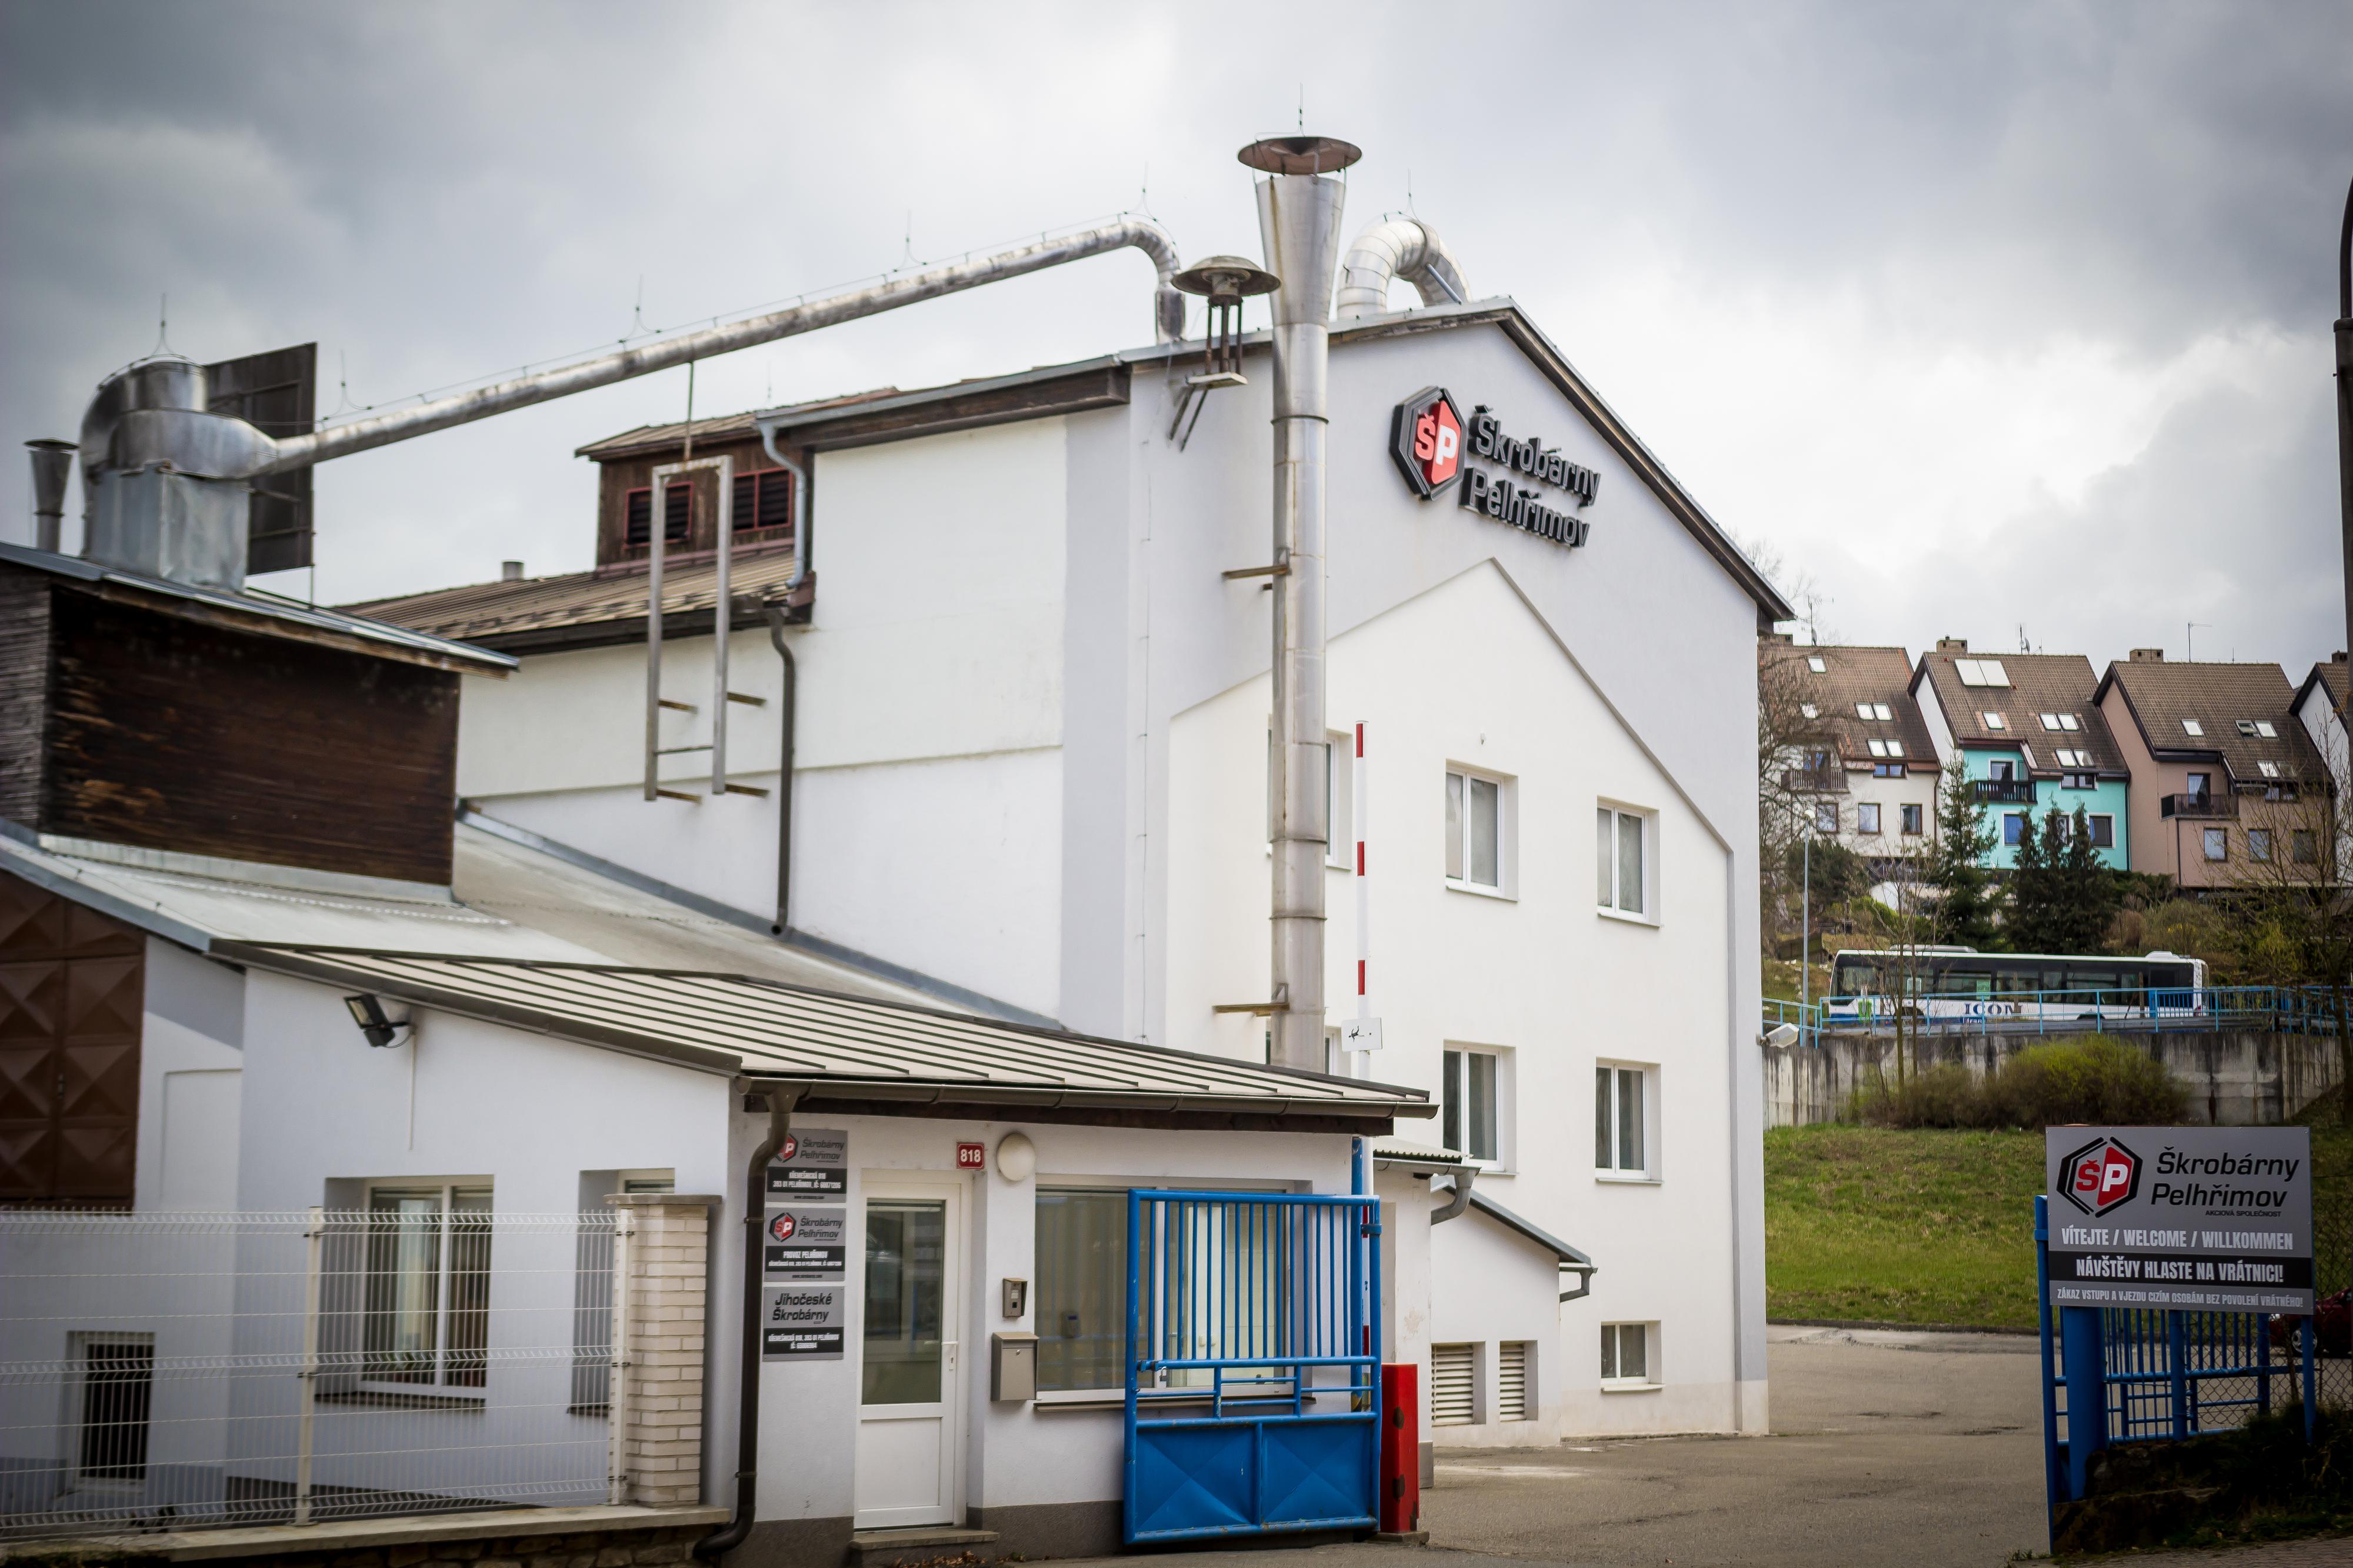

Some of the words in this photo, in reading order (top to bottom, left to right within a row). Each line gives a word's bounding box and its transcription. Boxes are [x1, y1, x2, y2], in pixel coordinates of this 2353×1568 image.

[1415, 412, 1458, 465] ŠP
[1468, 405, 1601, 508] Škrobárny
[1459, 466, 1591, 548] Pelhřimov
[802, 1137, 845, 1151] Škrobárny
[960, 1149, 981, 1163] 818
[2076, 1159, 2128, 1192] ŠP
[2157, 1146, 2300, 1182] Škrobárny
[2151, 1183, 2288, 1207] Pelhřimov
[798, 1229, 838, 1238] Pelhřimov
[800, 1216, 843, 1229] Škrobárny
[2061, 1224, 2109, 1245] VÍTEJTE
[2123, 1229, 2187, 1247] WELCOME
[2201, 1231, 2293, 1250] WILLKOMMEN
[2076, 1255, 2141, 1278] NÁVŠTĚVY
[2145, 1261, 2192, 1279] HLASTE
[2196, 1263, 2214, 1280] NA
[2218, 1259, 2284, 1283] VRÁTNICI!
[775, 1293, 833, 1306] Jihočeské
[2057, 1287, 2080, 1300] ZÁKAZ
[2082, 1289, 2109, 1300] VSTUPU
[2111, 1290, 2117, 1300] A
[2118, 1290, 2147, 1302] VJEZDU
[2148, 1290, 2169, 1303] CIZÍM
[2172, 1292, 2204, 1304] OSOBÁM
[2207, 1293, 2221, 1305] BEZ
[2222, 1293, 2259, 1306] POVOLENÍ
[2261, 1295, 2304, 1307] VRÁTNÉHO!
[772, 1306, 830, 1322] Škrobárny
